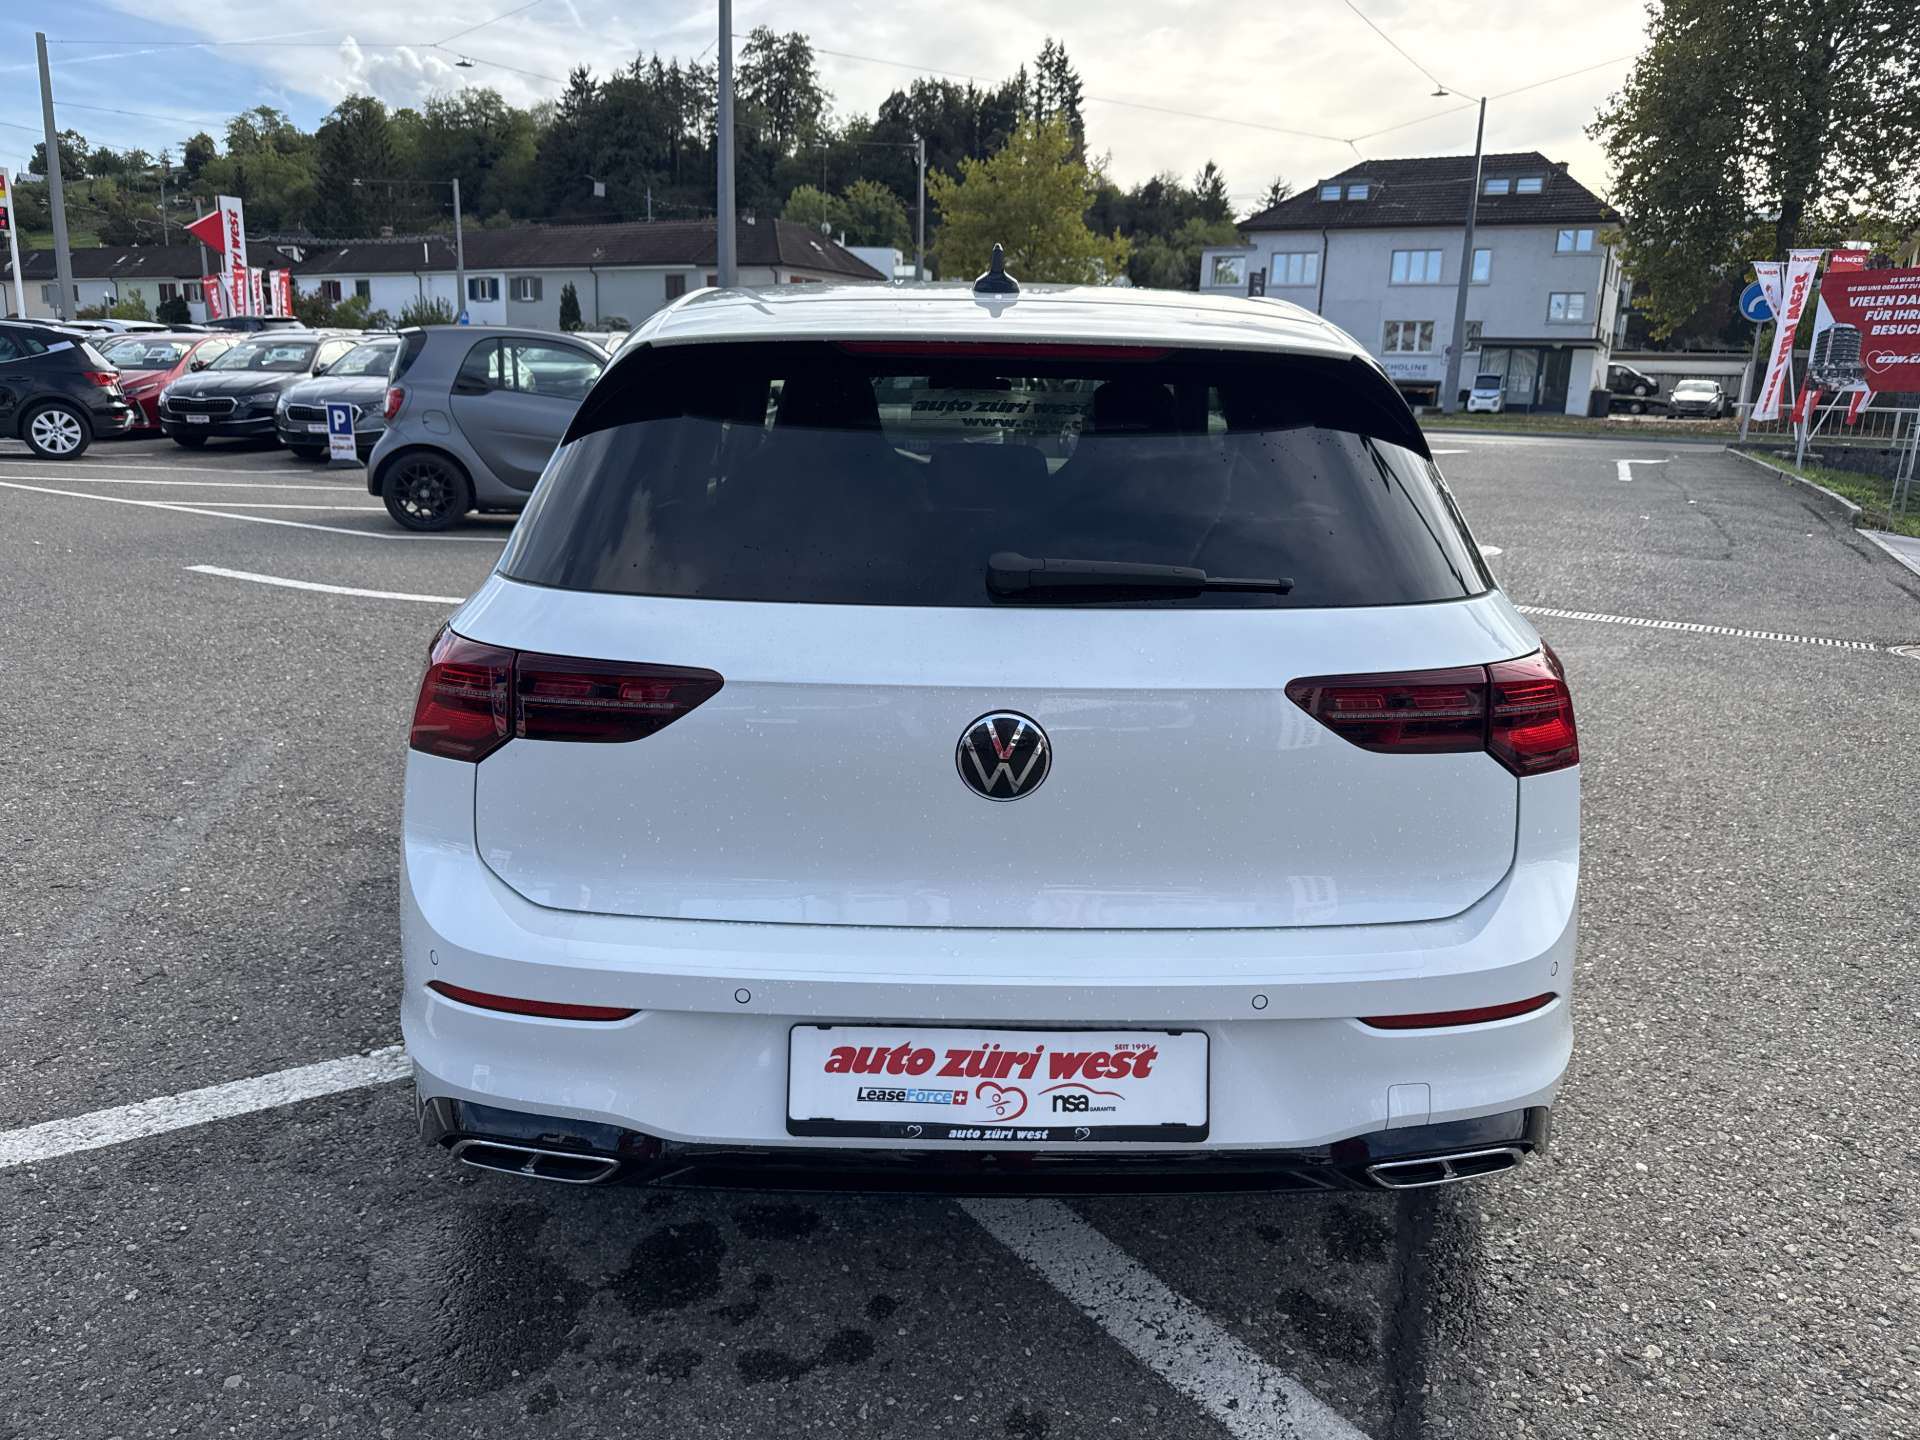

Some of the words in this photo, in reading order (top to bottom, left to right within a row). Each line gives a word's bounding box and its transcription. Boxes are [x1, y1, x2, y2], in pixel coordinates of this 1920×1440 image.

[1849, 295, 1895, 307] VIELEN
[1864, 307, 1893, 321] FÜR
[912, 399, 972, 415] auto
[332, 409, 346, 431] P
[1114, 1043, 1129, 1051] SEIT
[1131, 1043, 1150, 1051] 1991
[824, 1041, 936, 1076] auto
[936, 1043, 1046, 1080] züri
[1049, 1045, 1158, 1079] west
[856, 1087, 953, 1103] LeaseForce
[1052, 1094, 1089, 1112] nsa
[948, 1128, 981, 1139] auto
[983, 1128, 1014, 1139] züri
[1016, 1129, 1049, 1140] west
